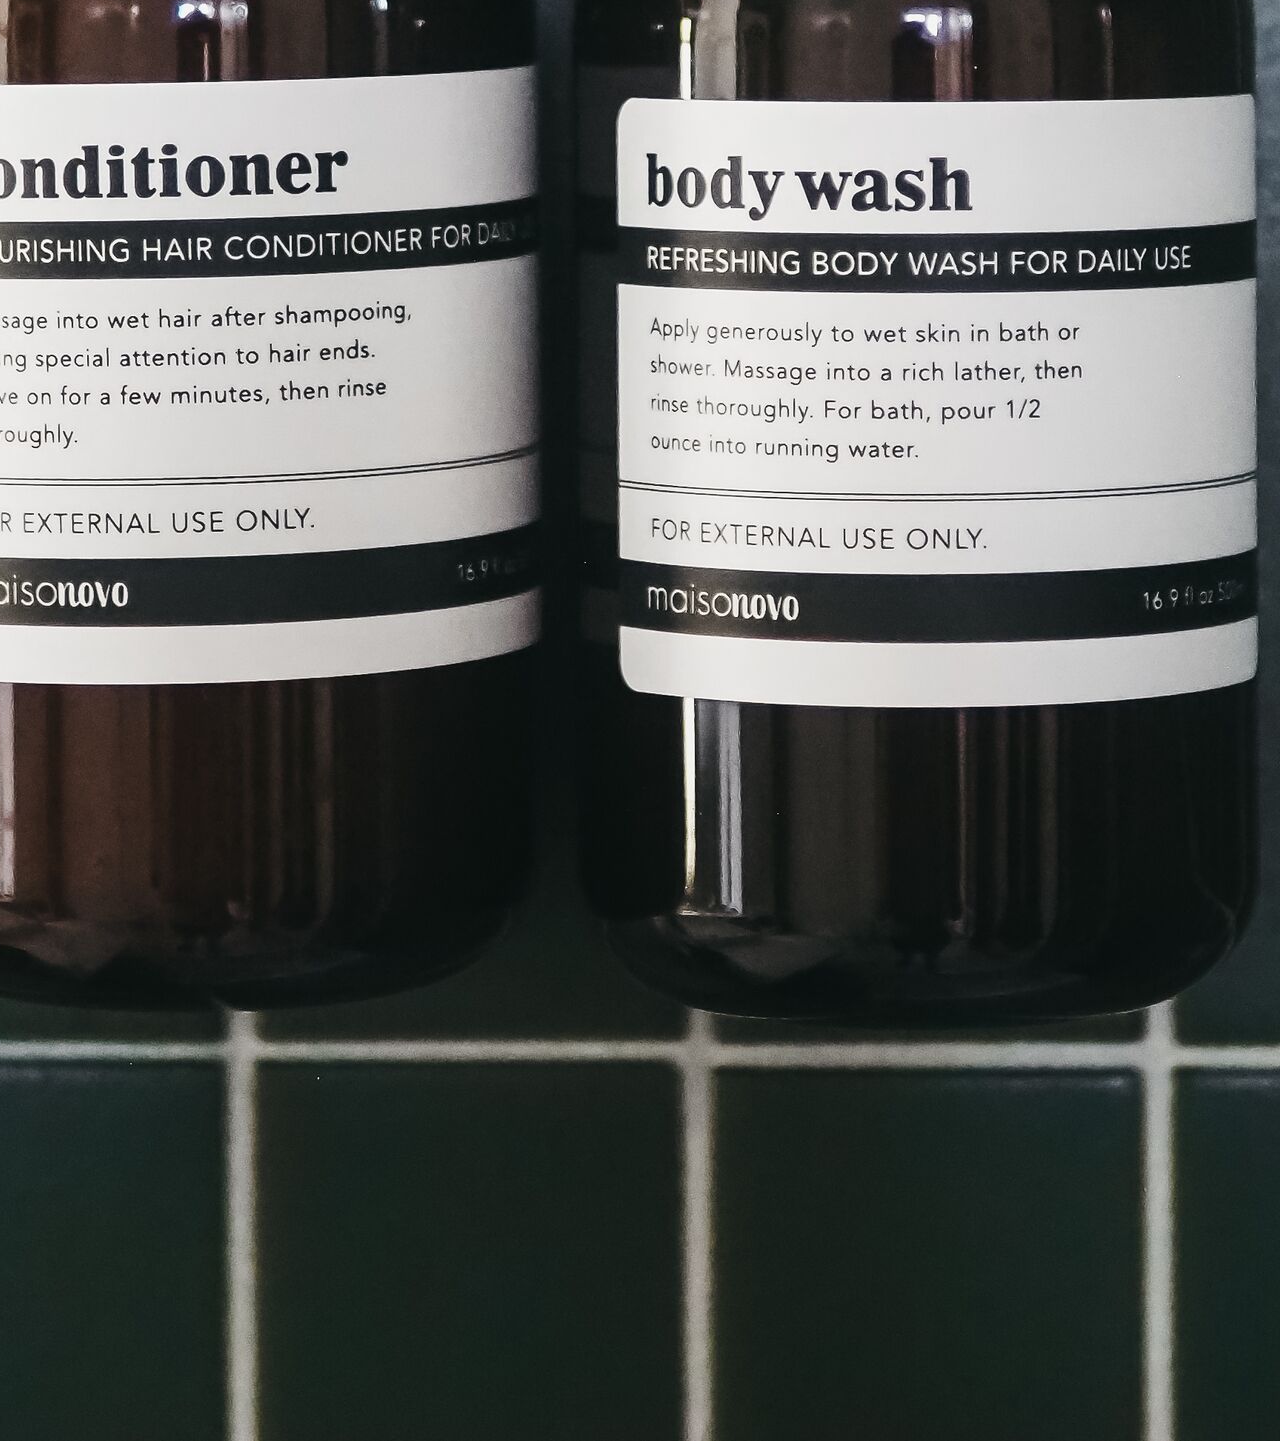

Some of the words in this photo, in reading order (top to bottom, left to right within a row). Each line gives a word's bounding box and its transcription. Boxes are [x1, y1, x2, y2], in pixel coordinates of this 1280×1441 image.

[646, 153, 785, 221] body
[794, 157, 973, 213] wash
[143, 237, 213, 262] HAIR
[224, 228, 423, 260] CONDITIONER
[431, 224, 471, 249] FOR
[646, 245, 801, 275] REFRESHING
[812, 251, 898, 276] BODY
[908, 251, 999, 276] WASH
[1010, 250, 1067, 274] FOR
[1078, 247, 1147, 273] DAILY
[1154, 245, 1191, 270] USE
[56, 310, 99, 330] into
[108, 313, 149, 329] wet
[158, 307, 202, 329] hair
[210, 306, 266, 327] after
[274, 300, 412, 329] shampooing,
[649, 317, 699, 344] Apply
[706, 321, 822, 347] generously
[831, 326, 854, 342] to
[864, 327, 906, 343] wet
[915, 323, 961, 343] skin
[970, 324, 990, 342] in
[998, 321, 1049, 342] bath
[1058, 327, 1079, 340] or
[35, 347, 111, 372] special
[119, 346, 226, 367] attention
[235, 349, 259, 364] to
[268, 342, 311, 364] hair
[319, 339, 376, 362] ends.
[650, 354, 714, 377] shower.
[723, 359, 817, 386] Massage
[825, 362, 871, 381] into
[881, 368, 891, 381] a
[901, 362, 944, 381] rich
[953, 361, 1026, 384] lather,
[1034, 360, 1082, 380] then
[27, 392, 51, 405] on
[60, 385, 91, 405] for
[100, 392, 110, 405] a
[119, 383, 161, 405] few
[170, 382, 270, 408] minutes,
[279, 379, 329, 401] then
[337, 377, 387, 398] rinse
[650, 395, 688, 414] rinse
[696, 396, 814, 424] thoroughly.
[824, 400, 862, 420] For
[870, 400, 931, 423] bath,
[942, 406, 996, 425] pour
[1006, 399, 1041, 421] 1/2
[651, 434, 701, 453] ounce
[709, 435, 746, 455] into
[754, 437, 839, 463] running
[847, 440, 919, 460] water.
[23, 511, 161, 535] EXTERNAL
[172, 511, 225, 534] USE
[235, 508, 315, 533] ONLY.
[651, 518, 692, 543] FOR
[700, 522, 830, 549] EXTERNAL
[842, 527, 895, 550] USE
[906, 527, 988, 550] ONLY.
[647, 584, 799, 622] maisonovo
[1143, 588, 1178, 611] 169
